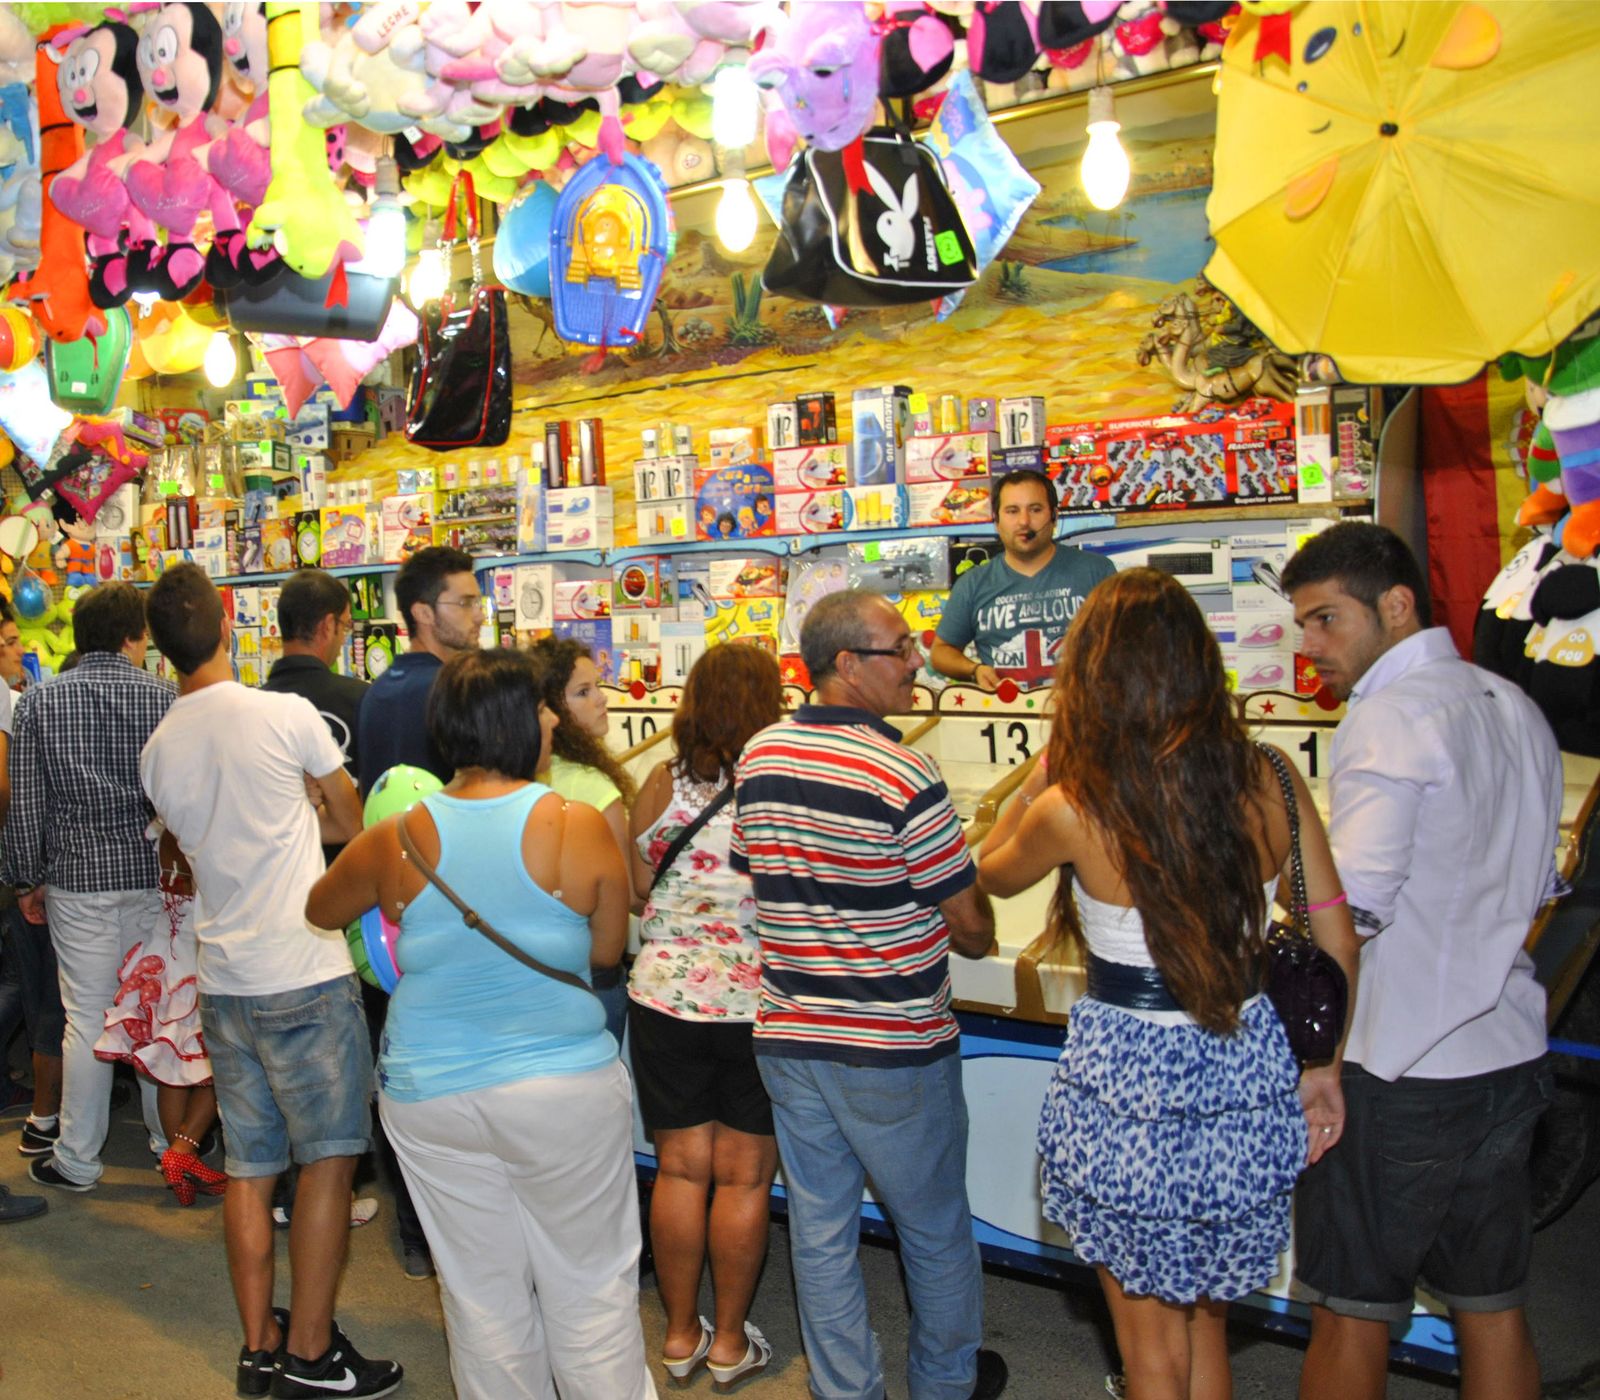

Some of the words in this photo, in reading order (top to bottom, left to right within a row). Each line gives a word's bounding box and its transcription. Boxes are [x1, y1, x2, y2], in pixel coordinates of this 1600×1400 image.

[377, 4, 409, 38] LECHE
[923, 216, 938, 272] PLAYBOY
[884, 396, 894, 438] VACUUM
[1108, 419, 1152, 431] SUPERIOR
[886, 442, 894, 462] JUG
[1228, 442, 1265, 452] RACING
[716, 469, 744, 481] Cara
[742, 473, 751, 484] a
[733, 482, 762, 495] Cara
[977, 603, 1016, 631] LIVE
[1019, 602, 1041, 620] AND
[1556, 649, 1584, 663] POU
[622, 716, 657, 748] 10
[980, 722, 1032, 765] 13
